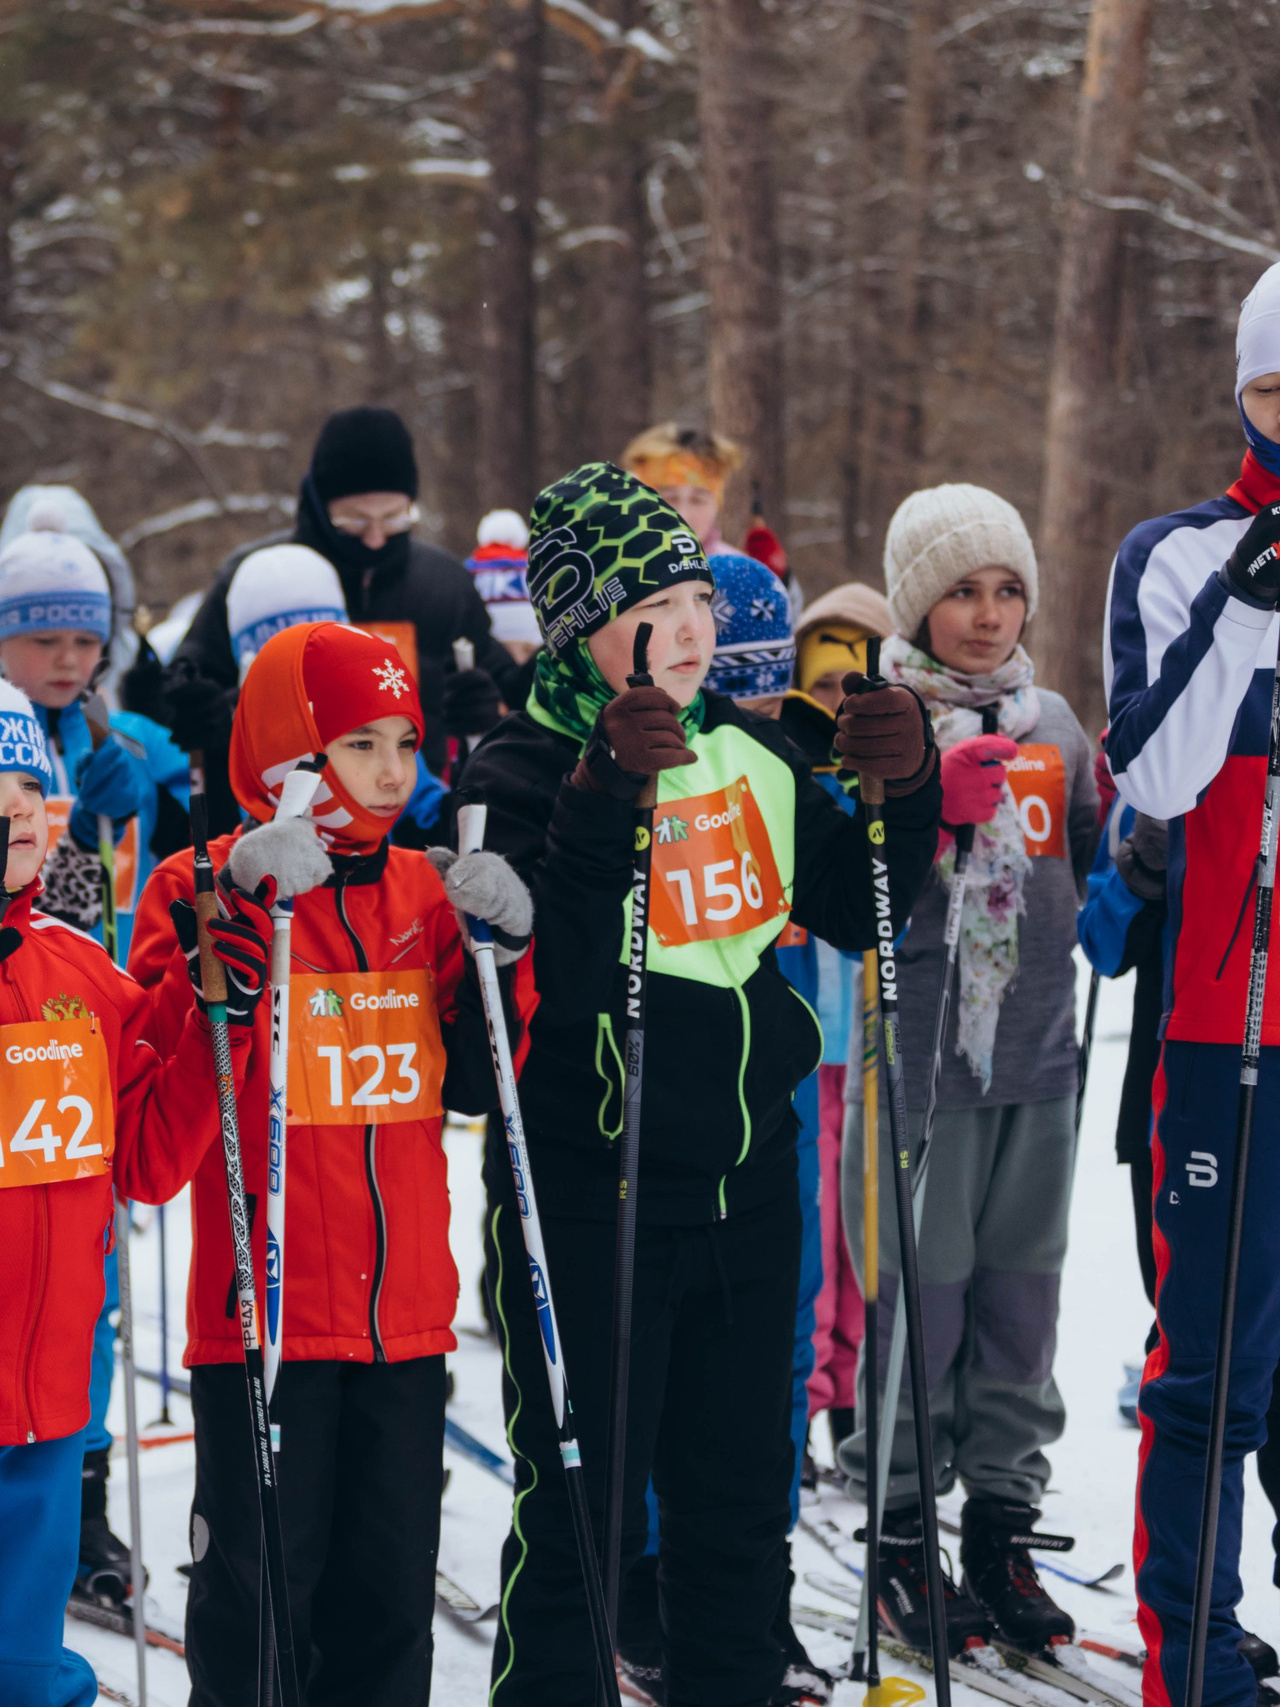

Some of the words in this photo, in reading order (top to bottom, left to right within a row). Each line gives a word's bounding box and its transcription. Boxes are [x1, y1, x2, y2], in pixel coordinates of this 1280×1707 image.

[665, 851, 763, 926] 156
[627, 867, 647, 1019] NORDWAY
[872, 857, 898, 1001] NORDWAY
[272, 986, 282, 1056] STC
[350, 988, 419, 1011] Goodline
[5, 1039, 83, 1064] Goodline
[317, 1042, 421, 1106] 123
[627, 1039, 641, 1077] 60%
[269, 1086, 283, 1196] X600
[899, 1150, 910, 1169] RS
[240, 1299, 256, 1348] ФЕДЯ
[1011, 1534, 1066, 1549] NORDWAY
